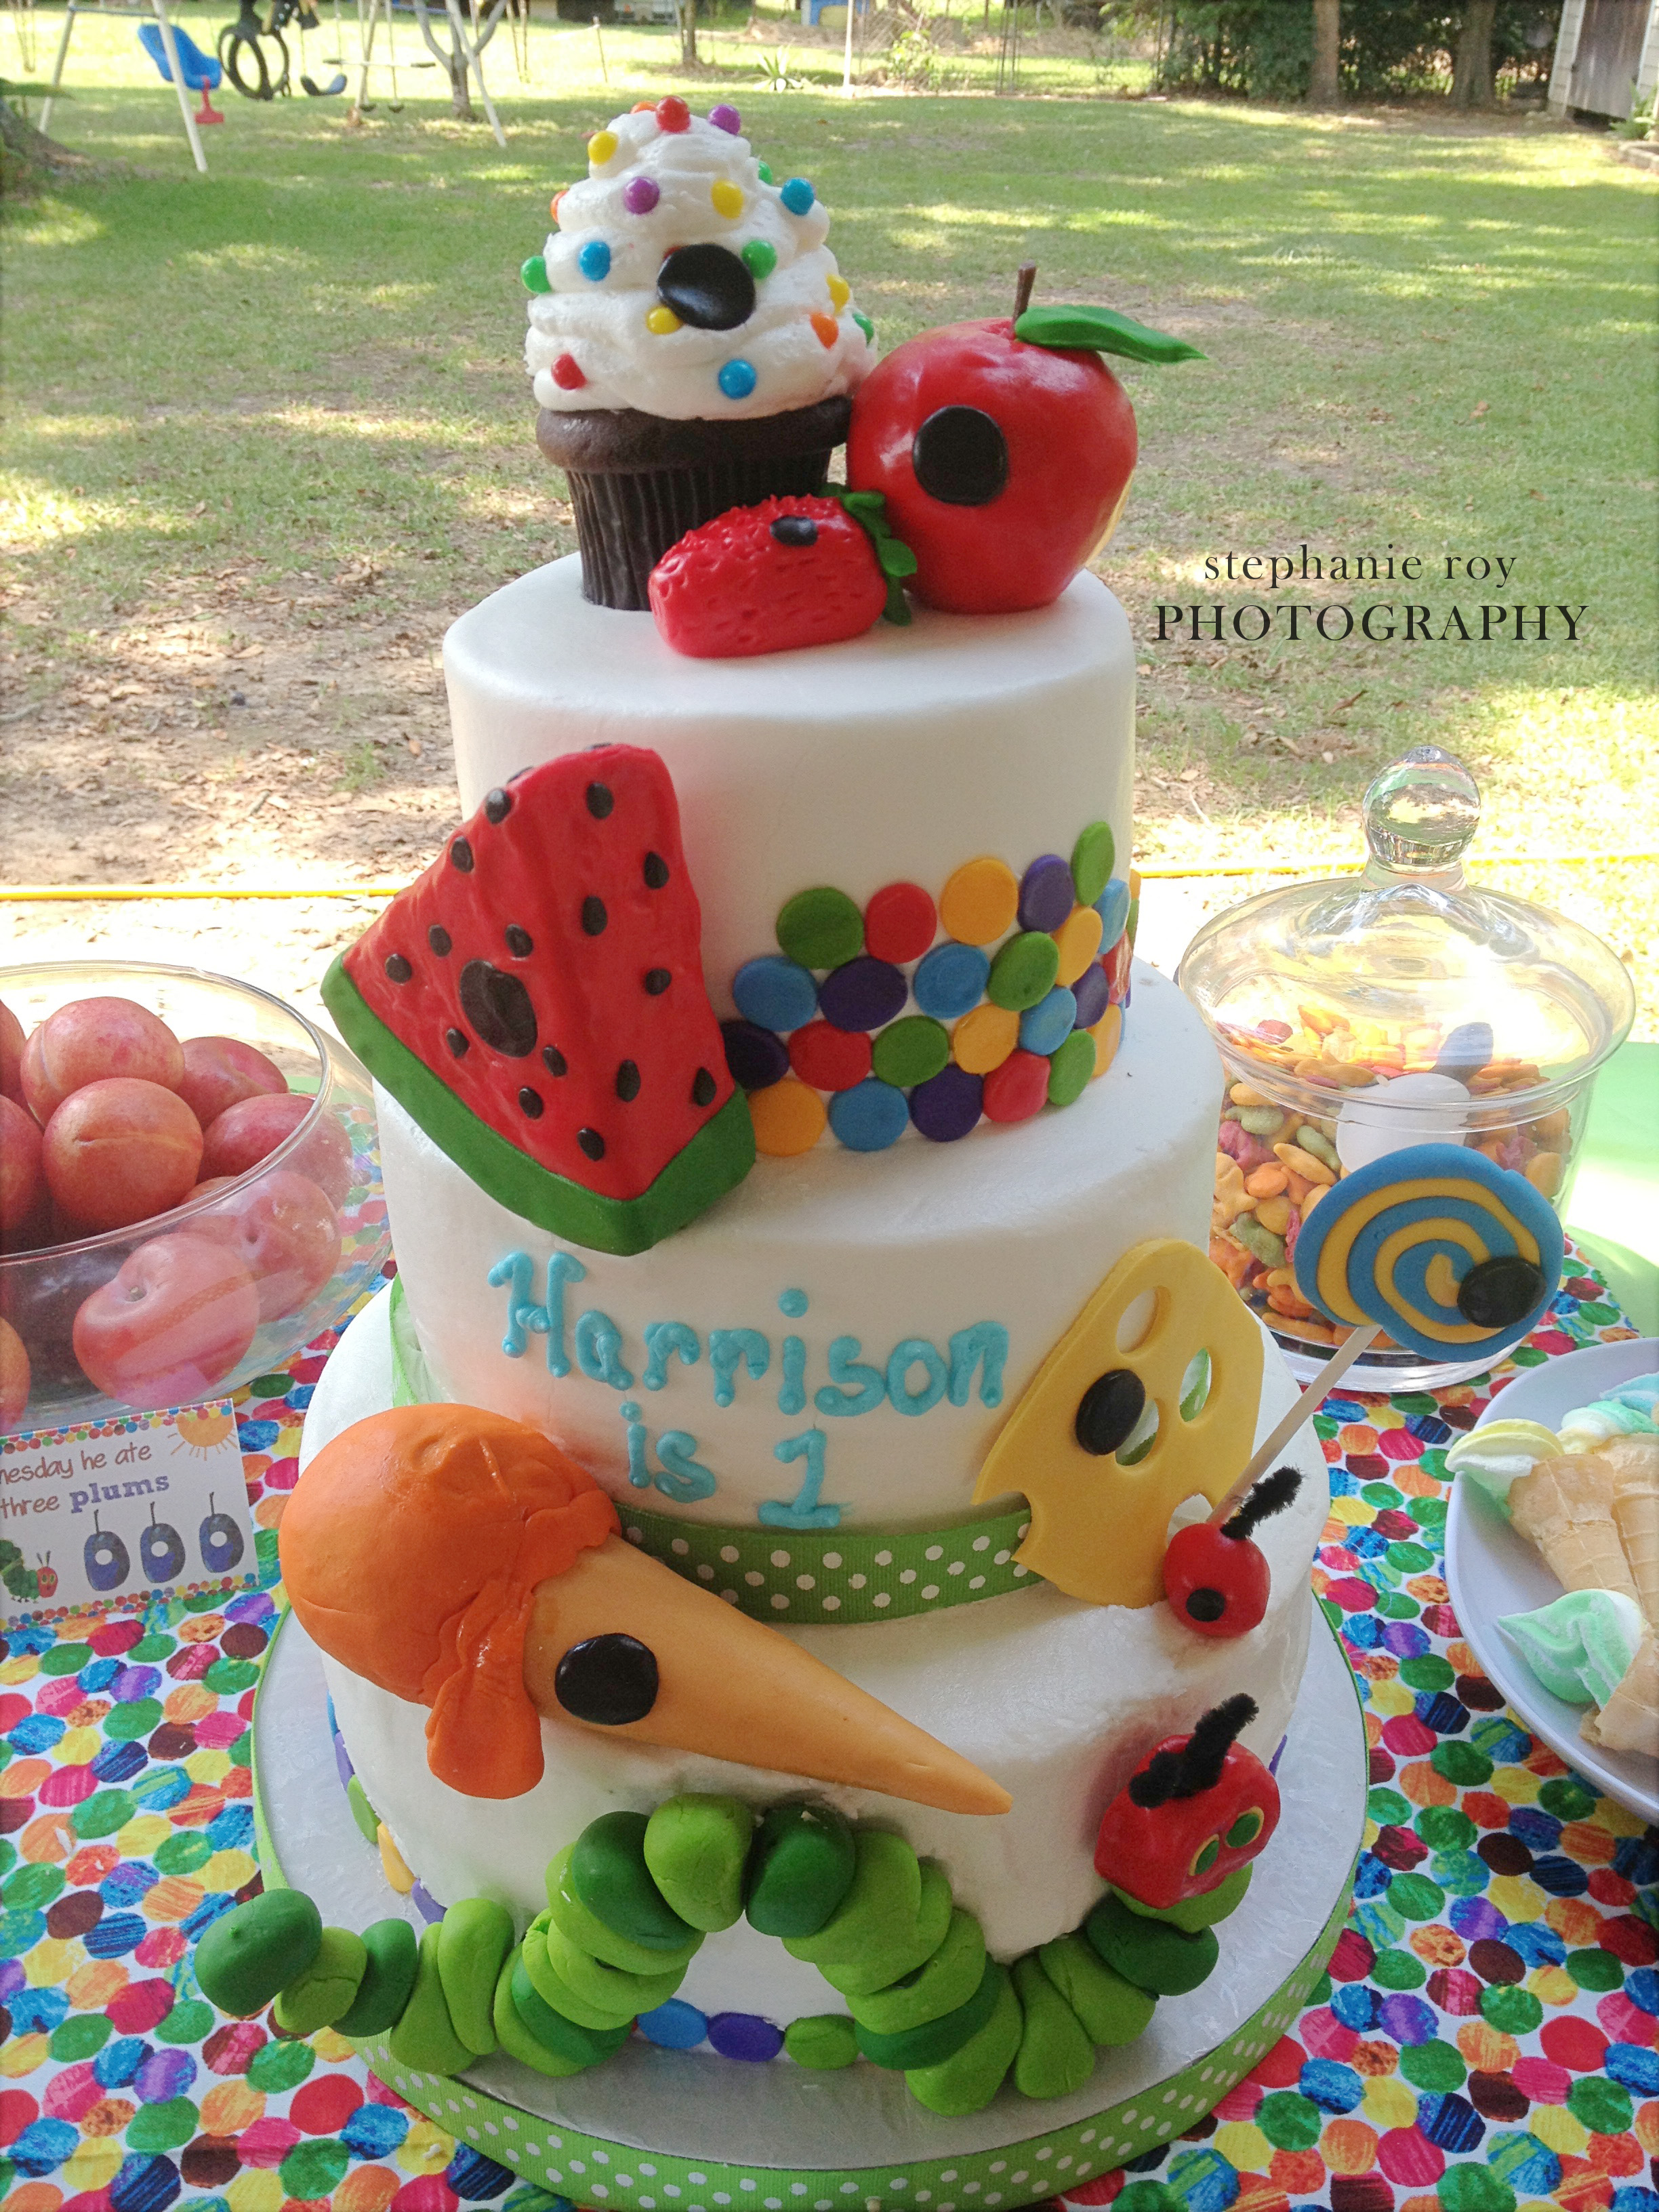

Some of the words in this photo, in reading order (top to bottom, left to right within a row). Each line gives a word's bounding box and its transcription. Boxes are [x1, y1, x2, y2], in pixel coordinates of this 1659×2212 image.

[487, 1251, 1009, 1416] Harrison
[0, 1496, 60, 1519] three
[69, 1475, 169, 1513] plums
[81, 1450, 107, 1470] he
[115, 1441, 152, 1465] ate
[619, 1401, 716, 1502] is
[757, 1429, 842, 1530] 1
